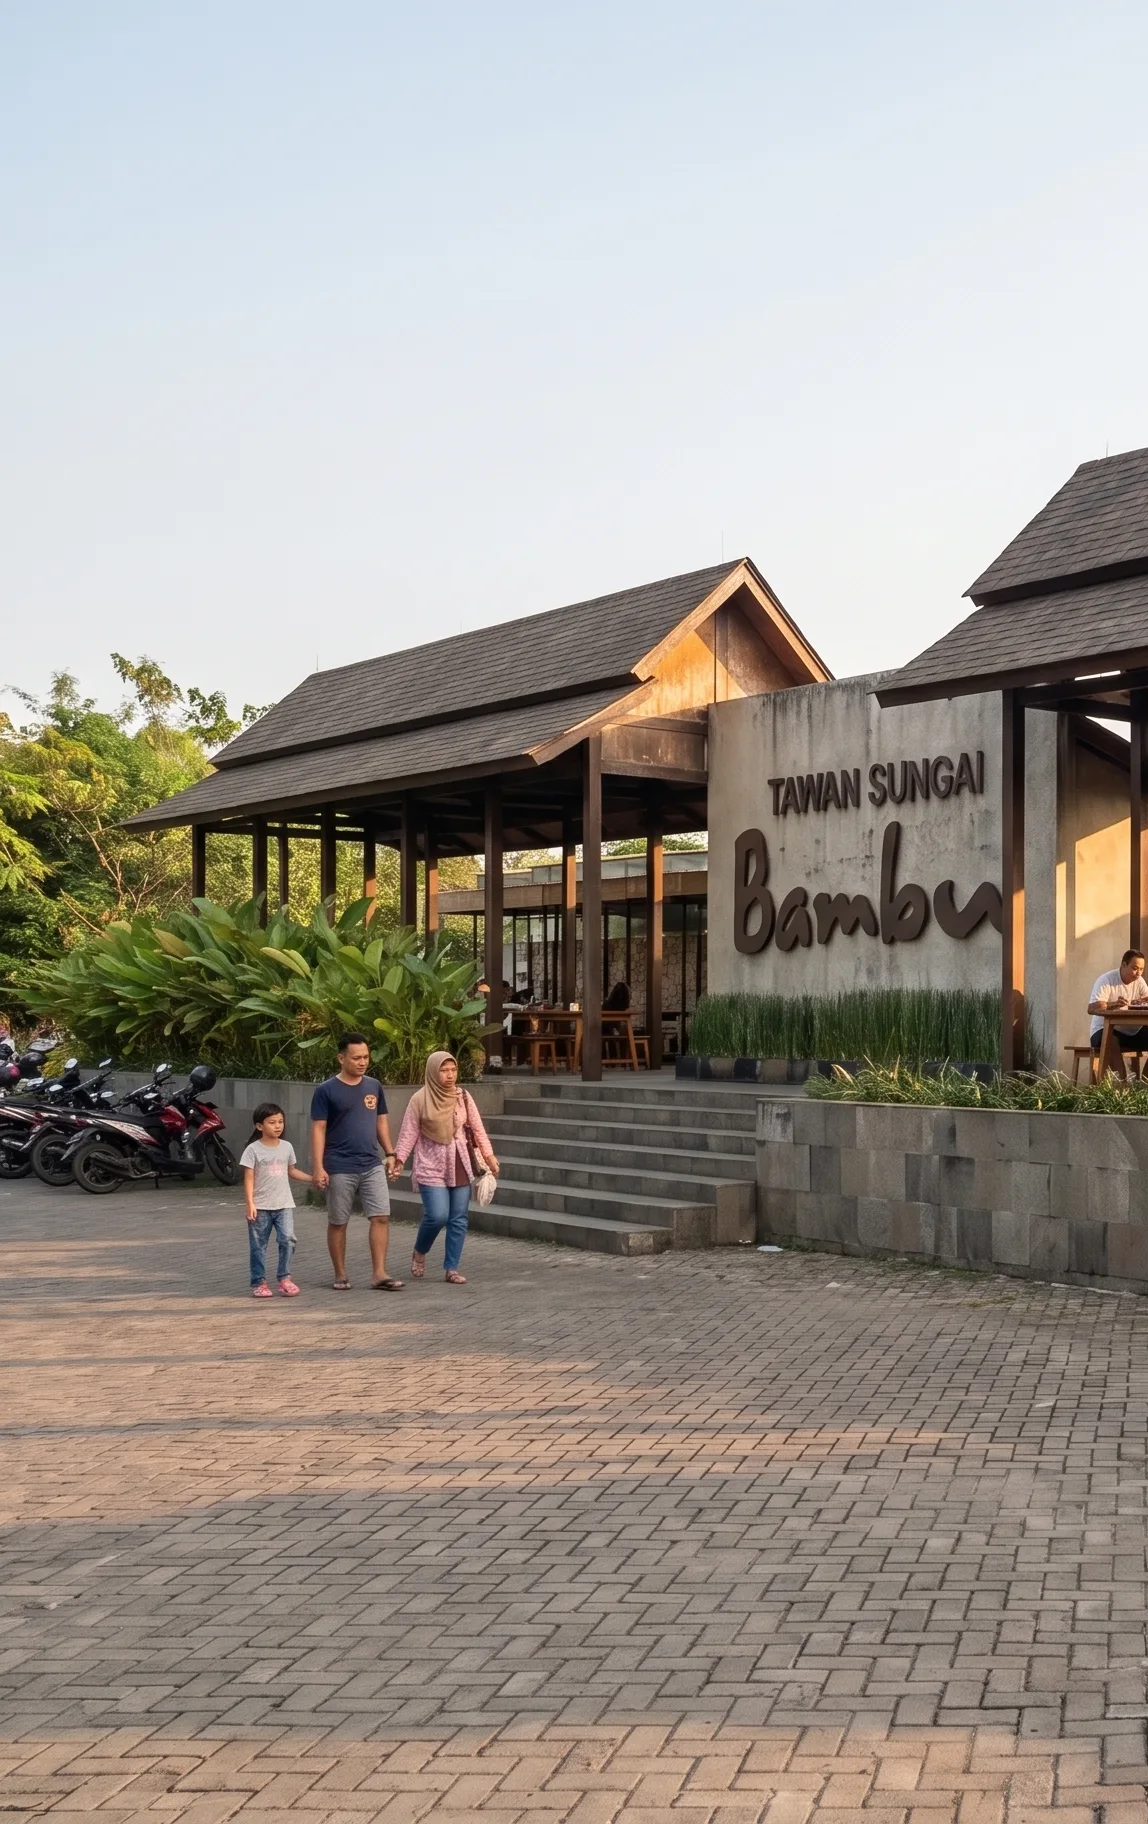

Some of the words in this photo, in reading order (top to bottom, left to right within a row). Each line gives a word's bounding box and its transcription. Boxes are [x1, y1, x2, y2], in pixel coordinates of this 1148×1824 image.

[768, 768, 861, 815] TAWAN
[868, 751, 985, 806] SUNGAI
[734, 820, 1003, 954] Bambu
